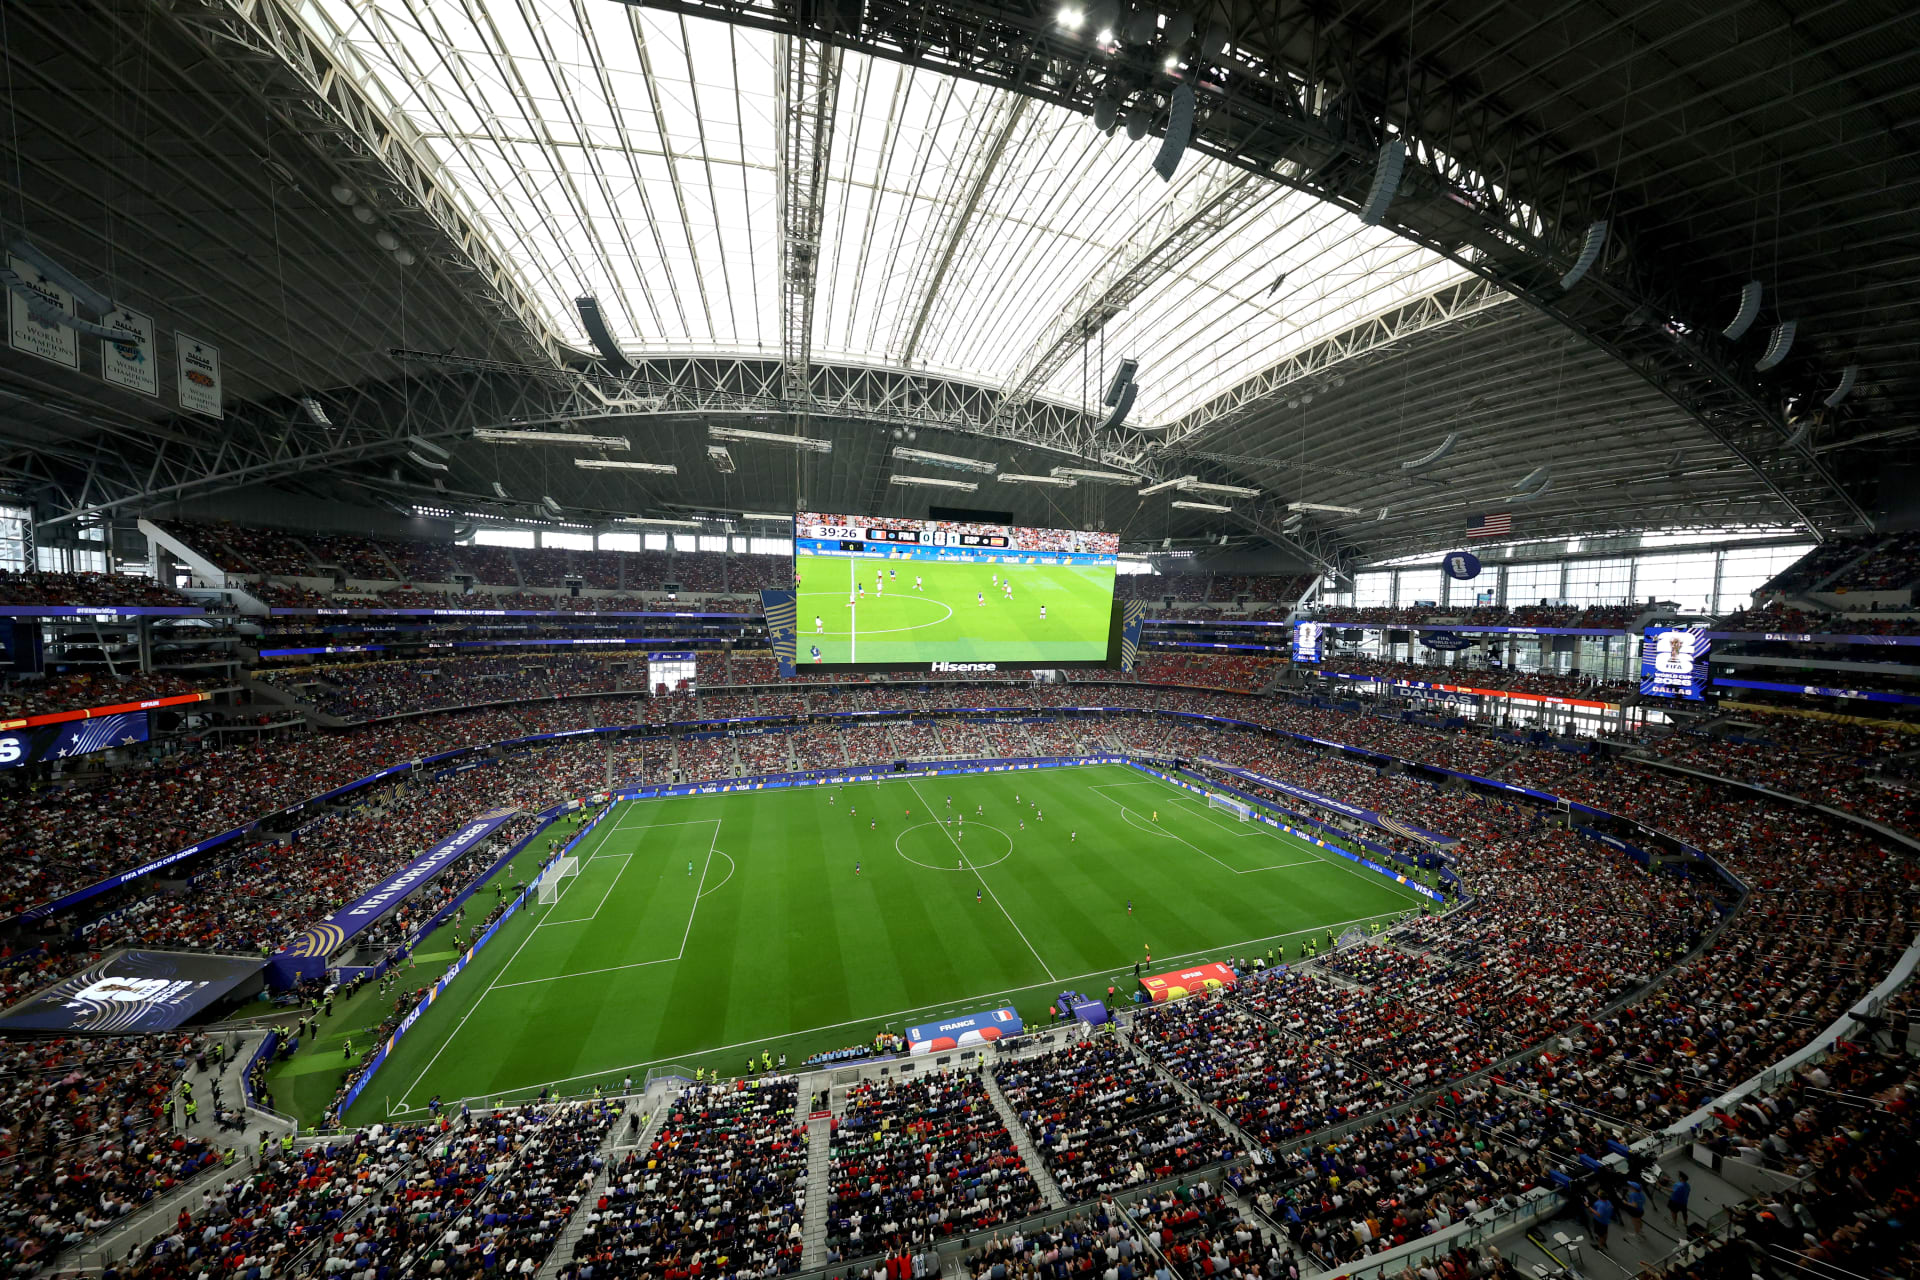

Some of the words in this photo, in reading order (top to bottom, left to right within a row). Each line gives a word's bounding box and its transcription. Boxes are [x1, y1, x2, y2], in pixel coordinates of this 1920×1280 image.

[115, 320, 142, 335] DALLAS
[27, 326, 63, 344] WORLD
[15, 330, 73, 356] CHAMPIONS
[188, 352, 210, 365] DALLAS
[819, 527, 857, 538] 39:26
[898, 532, 916, 541] FRA
[923, 534, 930, 542] 0
[951, 535, 956, 544] 1
[964, 536, 980, 544] ESP
[1765, 633, 1811, 641] DALLAS
[931, 661, 996, 672] Hisense
[1654, 678, 1692, 686] 2026
[1400, 687, 1472, 705] DALLAS
[1652, 686, 1692, 696] DALLAS
[1260, 777, 1297, 791] WORLD
[1295, 789, 1320, 799] CUP
[1318, 798, 1364, 814] 2026
[1265, 817, 1278, 828] VISA
[1296, 829, 1310, 842] VISA
[120, 871, 137, 882] FIFA
[137, 861, 163, 875] WORLD
[162, 855, 177, 865] CUP
[176, 846, 199, 860] 2026
[348, 891, 395, 915] FIFA
[382, 860, 437, 894] WORLD
[430, 845, 457, 861] CUP
[450, 823, 489, 846] 2026
[1368, 862, 1383, 874] VISA
[1413, 881, 1434, 899] VISA
[442, 963, 460, 986] VISA
[400, 1006, 420, 1033] VISA
[940, 1019, 976, 1032] FRANCE
[355, 1071, 372, 1096] VISA
